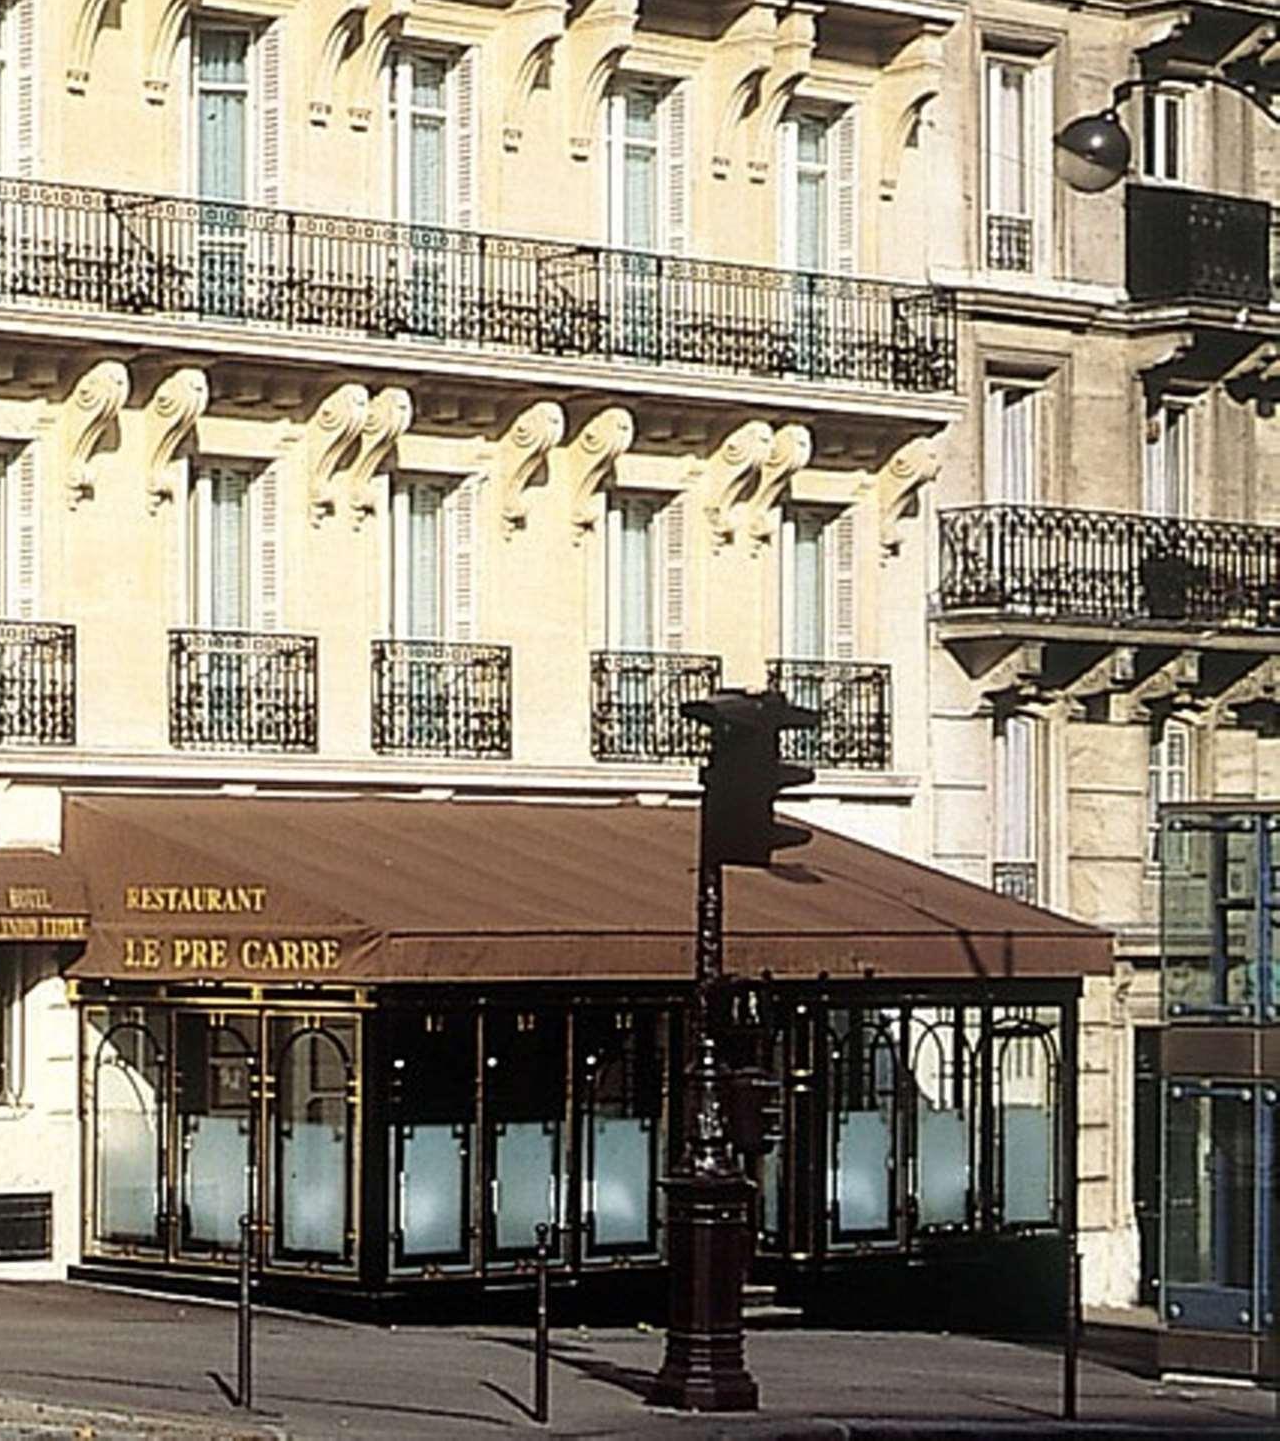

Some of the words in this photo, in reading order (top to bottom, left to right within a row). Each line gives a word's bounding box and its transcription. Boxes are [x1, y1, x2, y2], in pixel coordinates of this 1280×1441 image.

[125, 886, 267, 911] RESTAURANT
[124, 938, 161, 968] LE
[173, 939, 228, 968] PRE
[242, 939, 340, 970] CARRE
